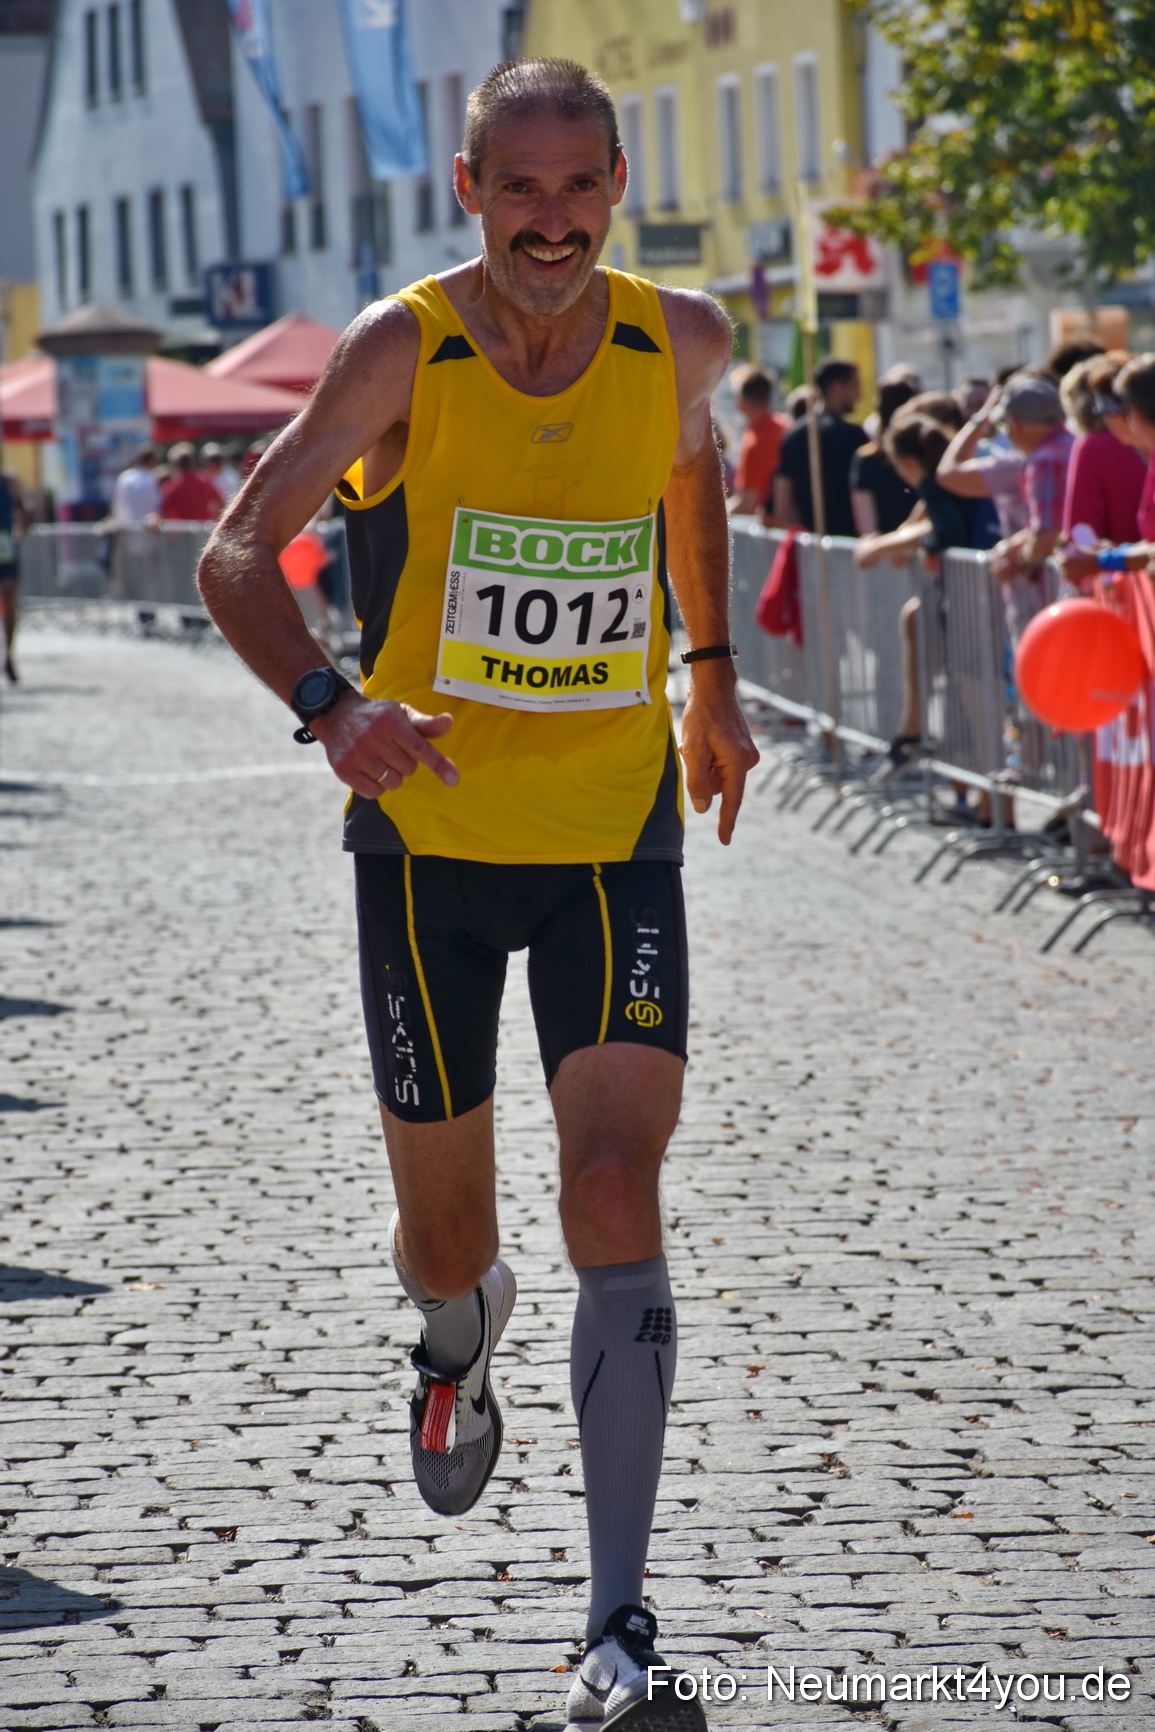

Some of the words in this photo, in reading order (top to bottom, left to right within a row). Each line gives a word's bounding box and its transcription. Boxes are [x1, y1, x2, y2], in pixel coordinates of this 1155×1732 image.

[474, 526, 637, 567] BOCK
[476, 584, 629, 645] 1012
[481, 655, 609, 688] THOMAS
